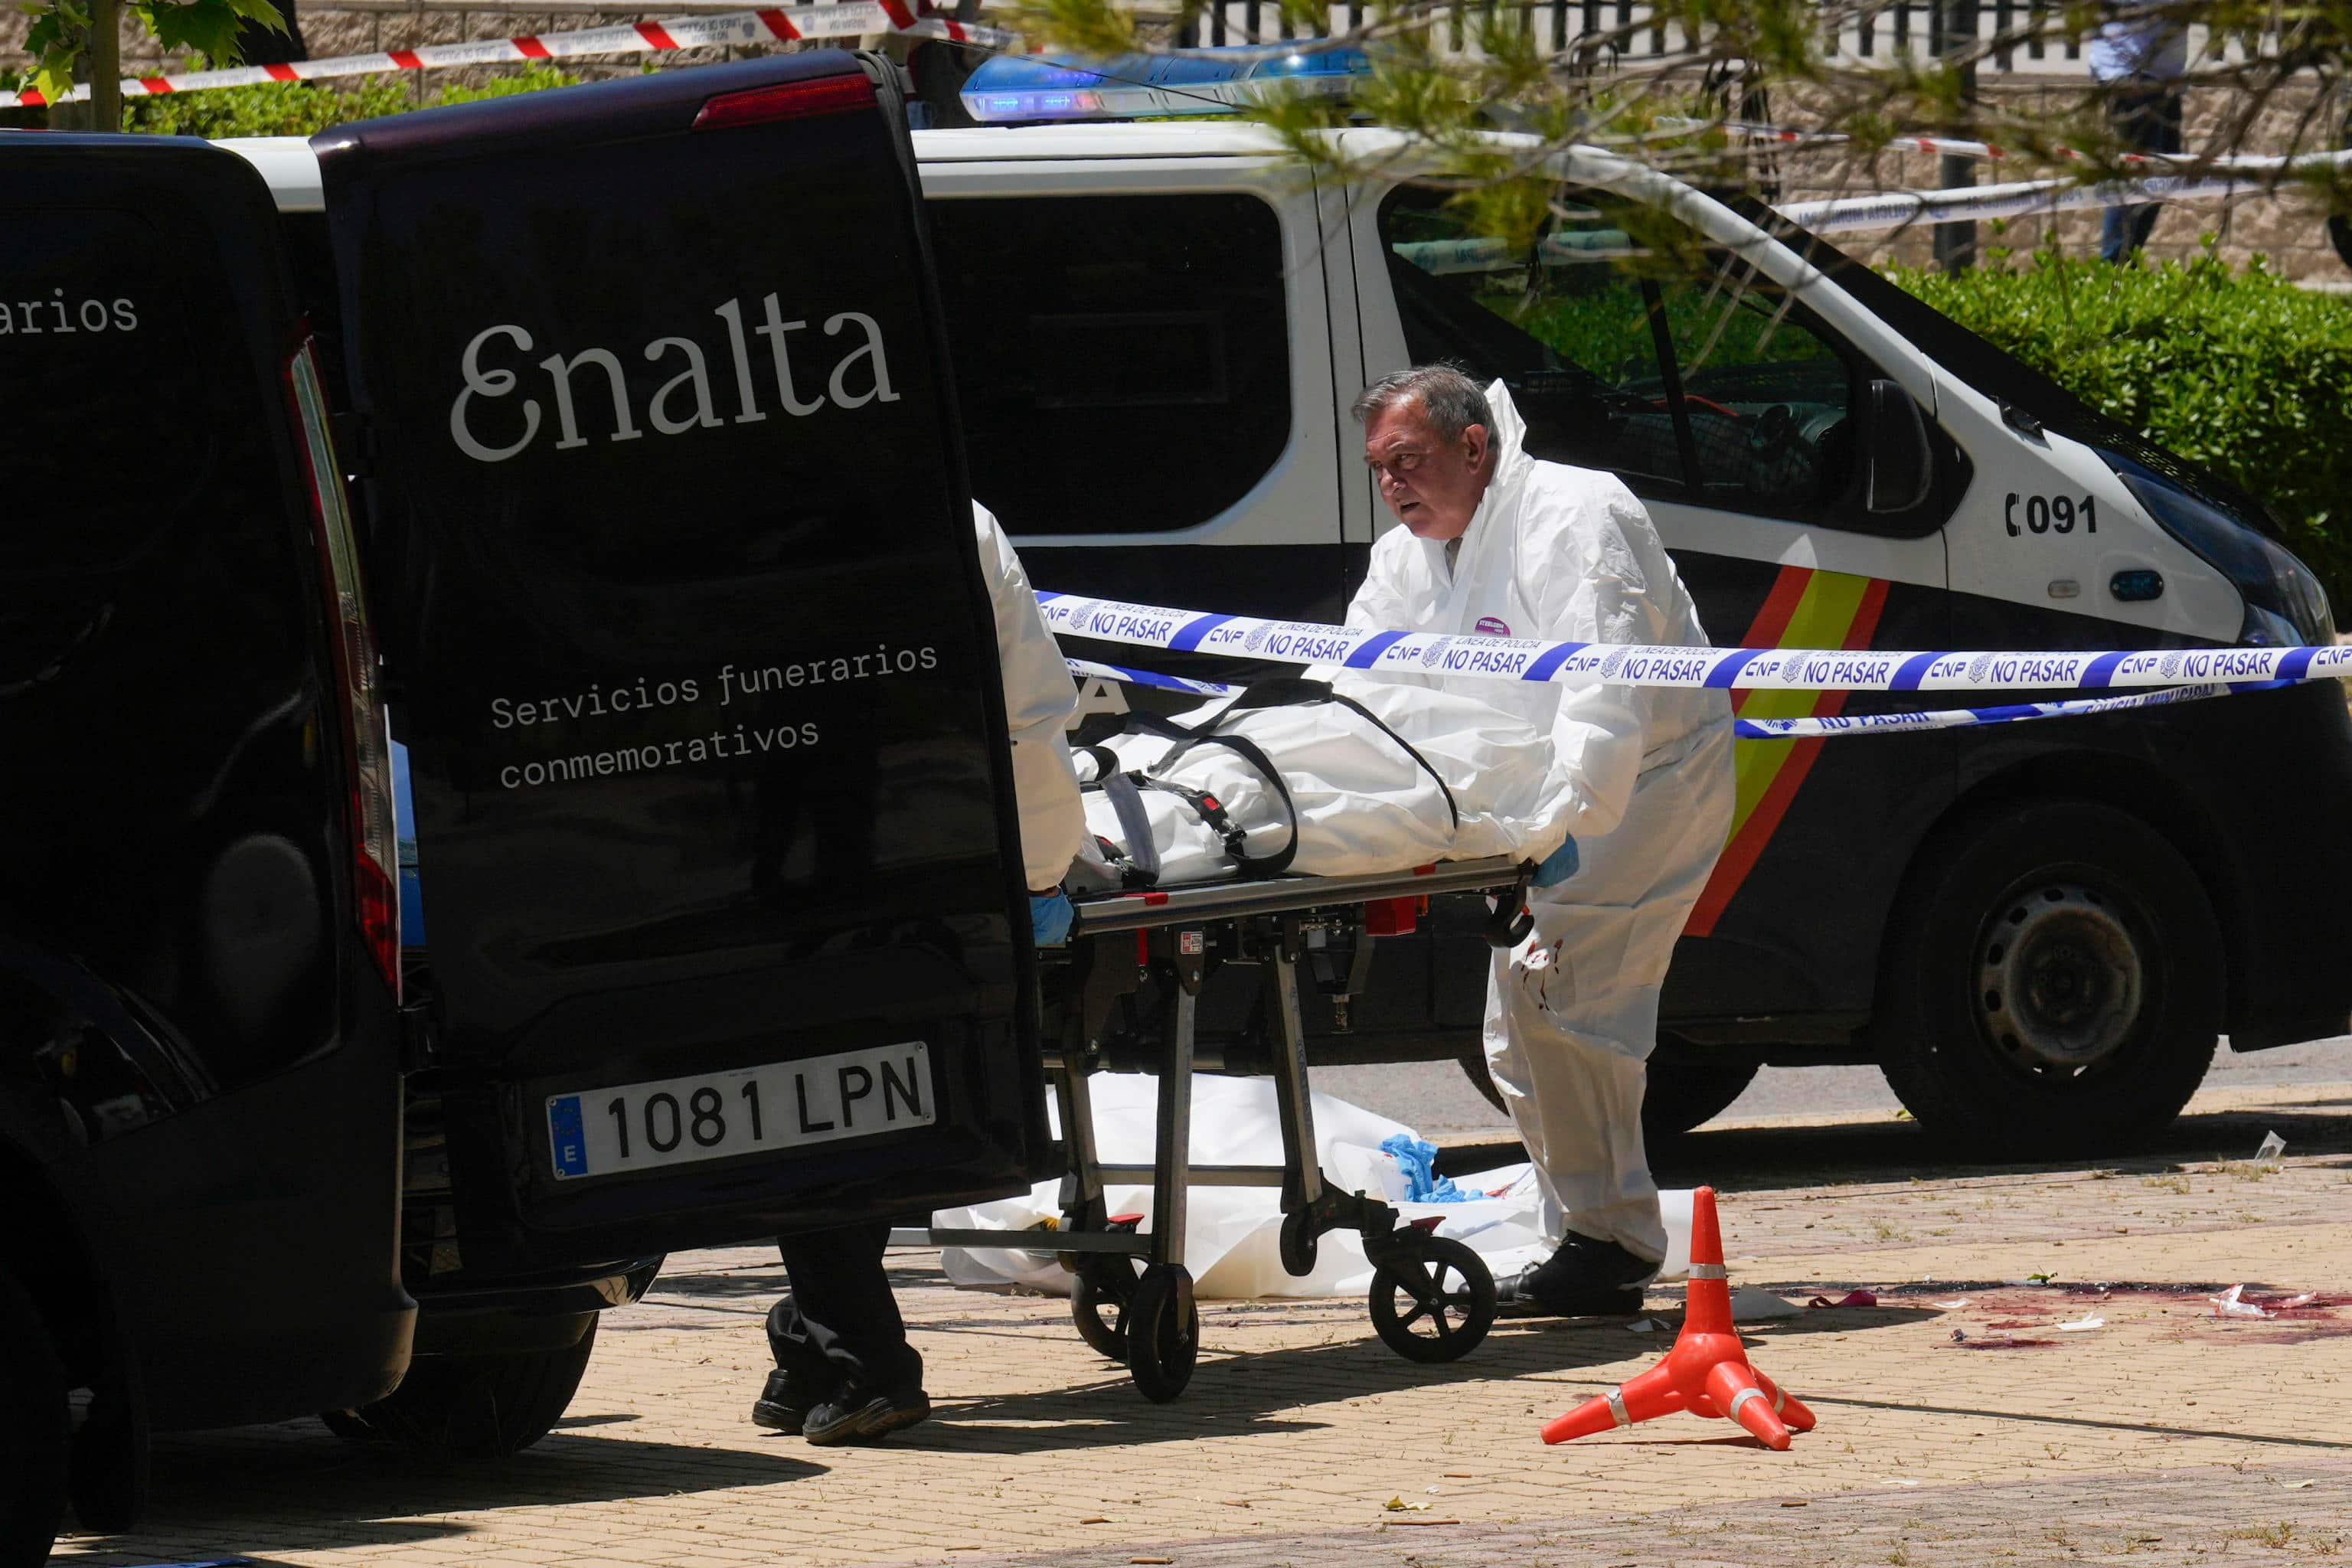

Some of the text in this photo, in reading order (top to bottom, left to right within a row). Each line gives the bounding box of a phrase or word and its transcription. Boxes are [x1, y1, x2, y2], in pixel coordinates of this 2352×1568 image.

[450, 292, 900, 462] Enalta
[2026, 495, 2096, 534] 091
[1090, 612, 1173, 642] NO PASAR
[1210, 629, 1244, 643] CNP
[1264, 634, 1350, 660] NO PASAR
[1387, 645, 1422, 661] CNP
[1442, 649, 1527, 674] NO PASAR
[1565, 657, 1601, 672] CNP
[1621, 658, 1707, 681] NO PASAR
[1746, 662, 1781, 677] CNP
[1804, 662, 1890, 684] NO PASAR
[1931, 662, 1967, 678] CNP
[1991, 659, 2079, 682] NO PASAR
[2121, 658, 2158, 674] CNP
[2184, 652, 2274, 678] NO PASAR
[492, 644, 937, 729] Servicios funerarios
[501, 722, 820, 789] conmemorativos
[608, 1057, 922, 1158] 1081 LPN
[564, 1145, 577, 1162] E
